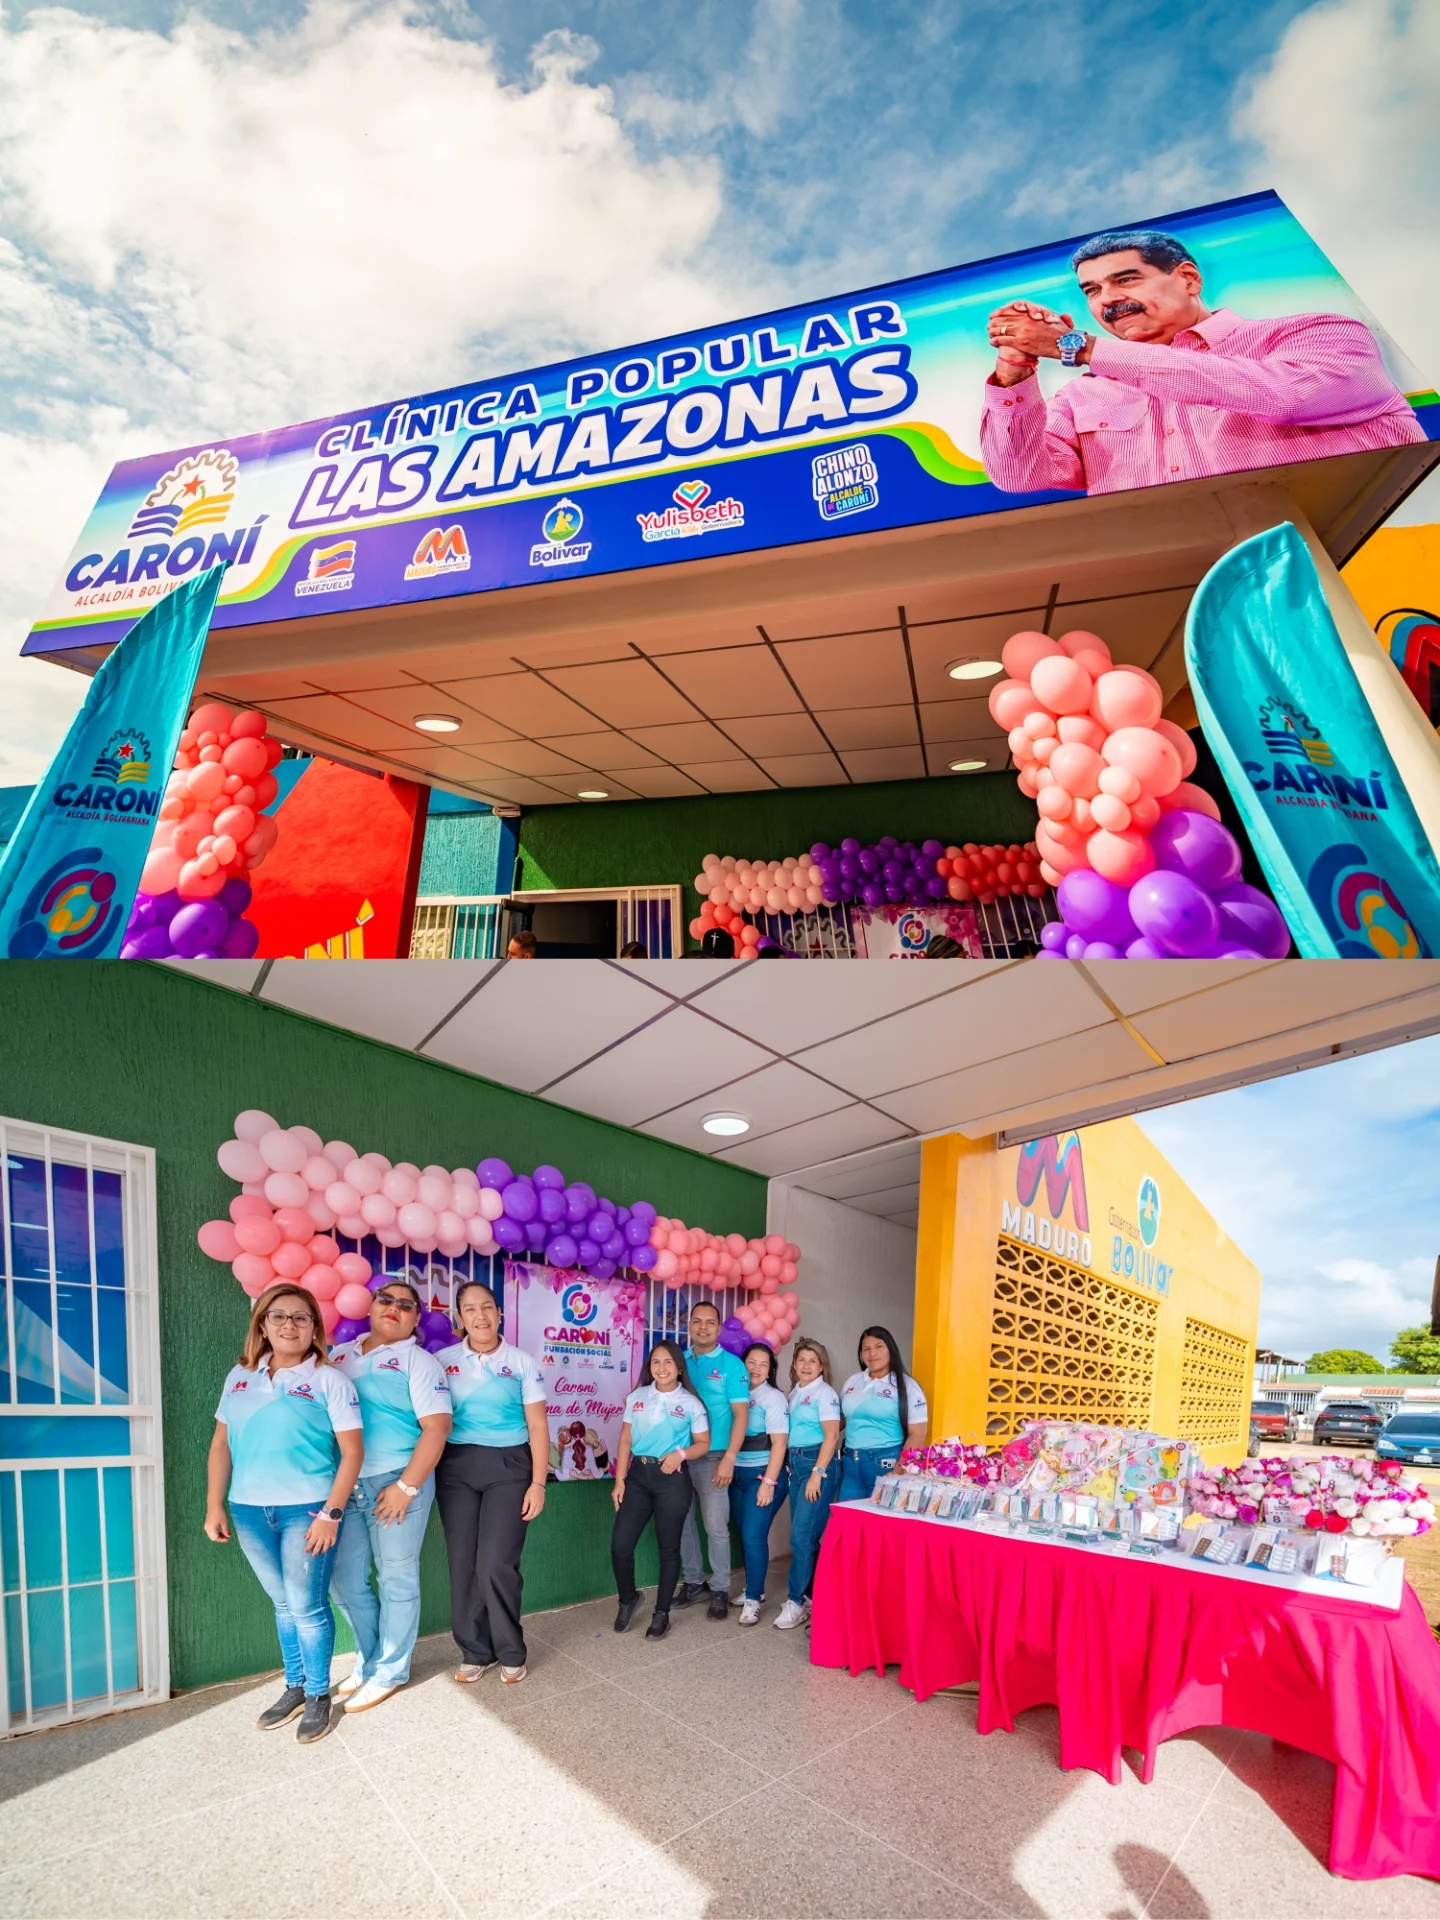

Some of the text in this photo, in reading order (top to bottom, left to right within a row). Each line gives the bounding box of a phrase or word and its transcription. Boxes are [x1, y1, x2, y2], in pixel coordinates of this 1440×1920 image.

[316, 303, 904, 459] CLÍNICA POPULAR
[291, 348, 913, 526] LAS AMAZONAS
[816, 446, 867, 477] CHINO
[818, 463, 873, 495] ALONZO
[830, 485, 863, 503] ALCALDE
[836, 490, 869, 511] CARONÍ
[640, 500, 741, 530] Yulisbeth
[645, 527, 680, 540] García
[702, 519, 742, 530] Gobernadora
[65, 514, 270, 592] CARONÍ
[532, 545, 589, 563] Bolívar
[74, 588, 134, 607] ALCALDÍA
[297, 581, 350, 594] VENEZUELA
[53, 782, 162, 816] CARONÍ
[1275, 796, 1328, 808] ALCALDÍA
[65, 810, 150, 826] ALCALDÍA BOLIVARIANA
[1001, 1200, 1092, 1268] MADURO
[543, 1345, 612, 1357] FUNDACIÓN SOCIAL
[565, 1400, 581, 1414] de
[585, 1399, 622, 1421] Mujer
